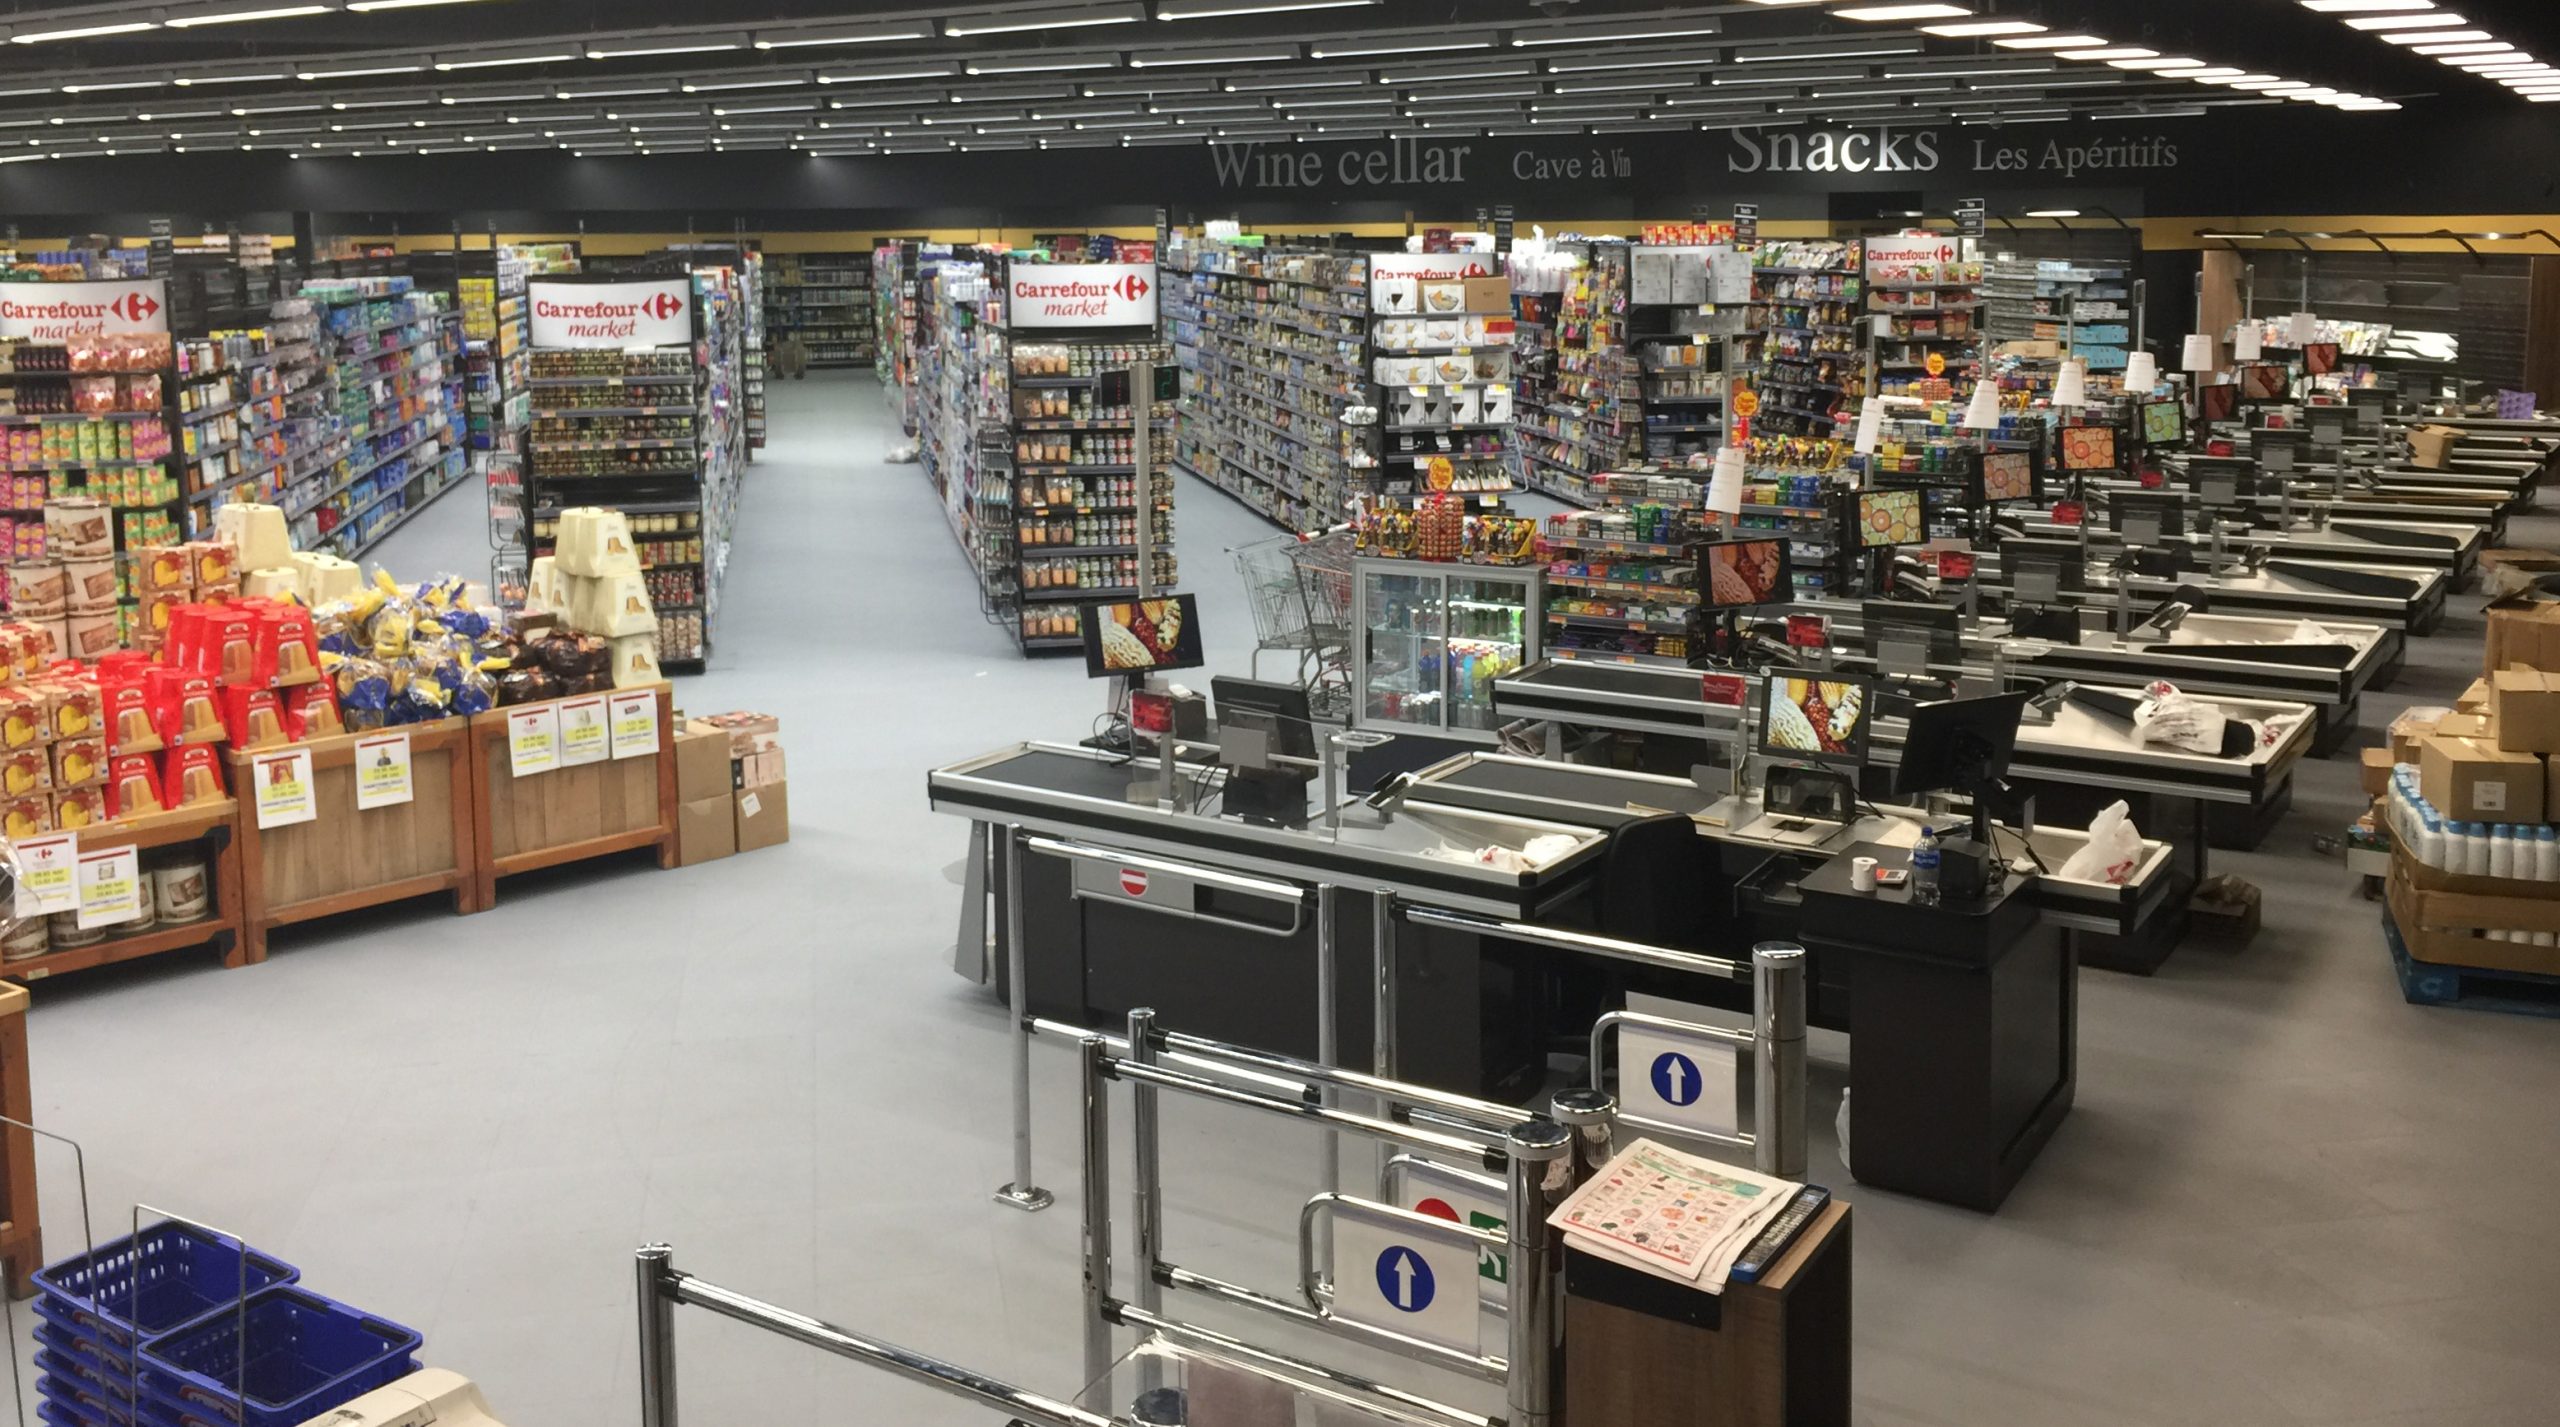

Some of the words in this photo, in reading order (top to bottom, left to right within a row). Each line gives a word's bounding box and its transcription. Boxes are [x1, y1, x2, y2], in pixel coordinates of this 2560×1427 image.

[1728, 126, 1939, 173] Snacks
[1973, 139, 2028, 171] Les
[2038, 136, 2178, 177] Apéritifs
[1211, 143, 1323, 188] Wine
[1338, 137, 1471, 185] cellar
[1512, 150, 1582, 180] Cave
[1590, 148, 1607, 178] à
[1611, 148, 1632, 177] Vin
[1867, 249, 1932, 262] Carrefour
[1015, 281, 1110, 298] Carrefour
[1, 300, 107, 319] Carrefour
[536, 301, 639, 318] Carrefour
[1044, 299, 1109, 318] market
[568, 319, 637, 339] market
